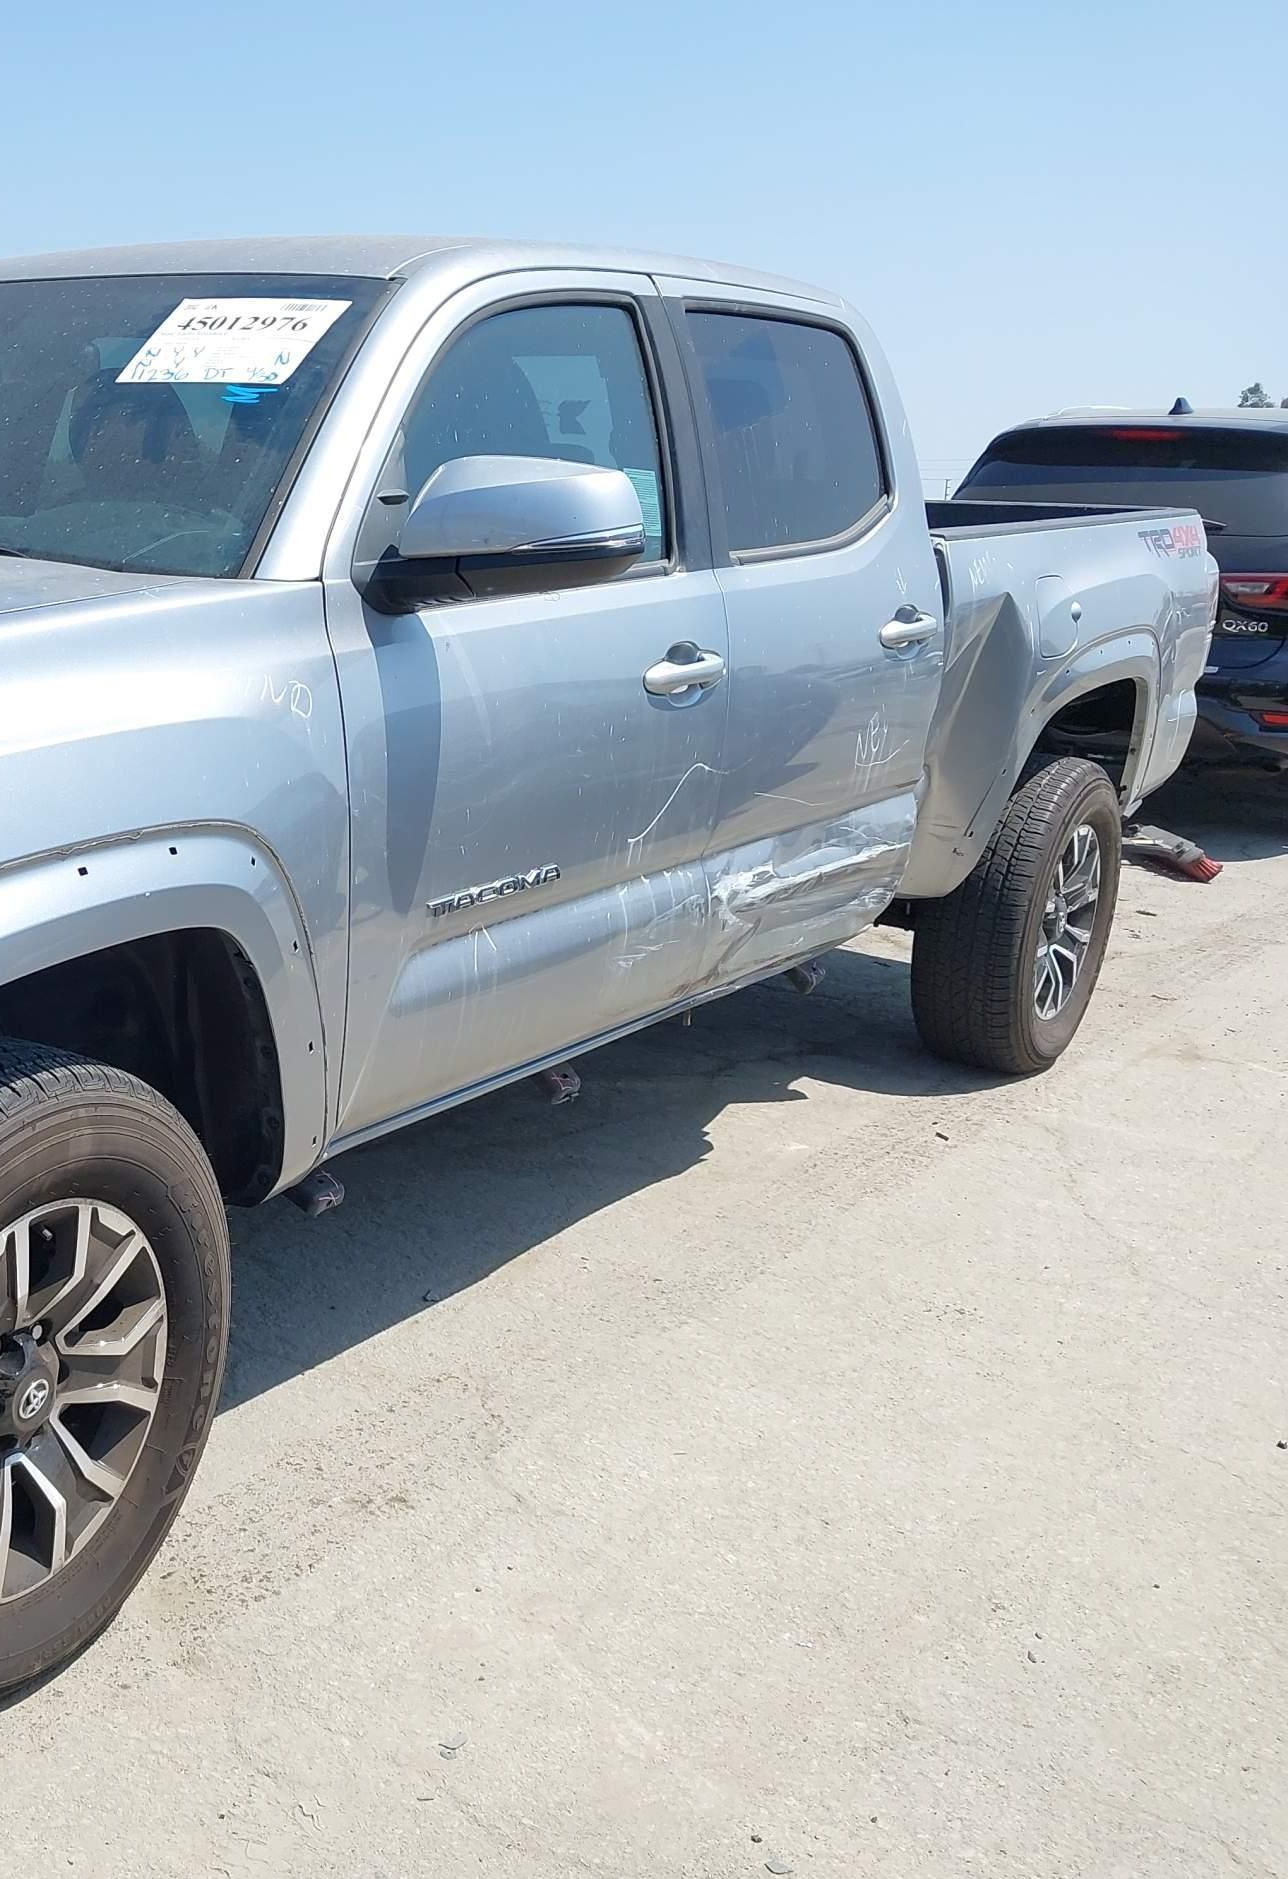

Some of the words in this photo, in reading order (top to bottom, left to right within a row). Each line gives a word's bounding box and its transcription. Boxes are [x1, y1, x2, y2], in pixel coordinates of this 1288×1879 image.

[177, 315, 309, 332] 45012976
[1137, 528, 1175, 558] TRD
[1222, 619, 1269, 633] QX60
[425, 862, 561, 917] TACOMA
